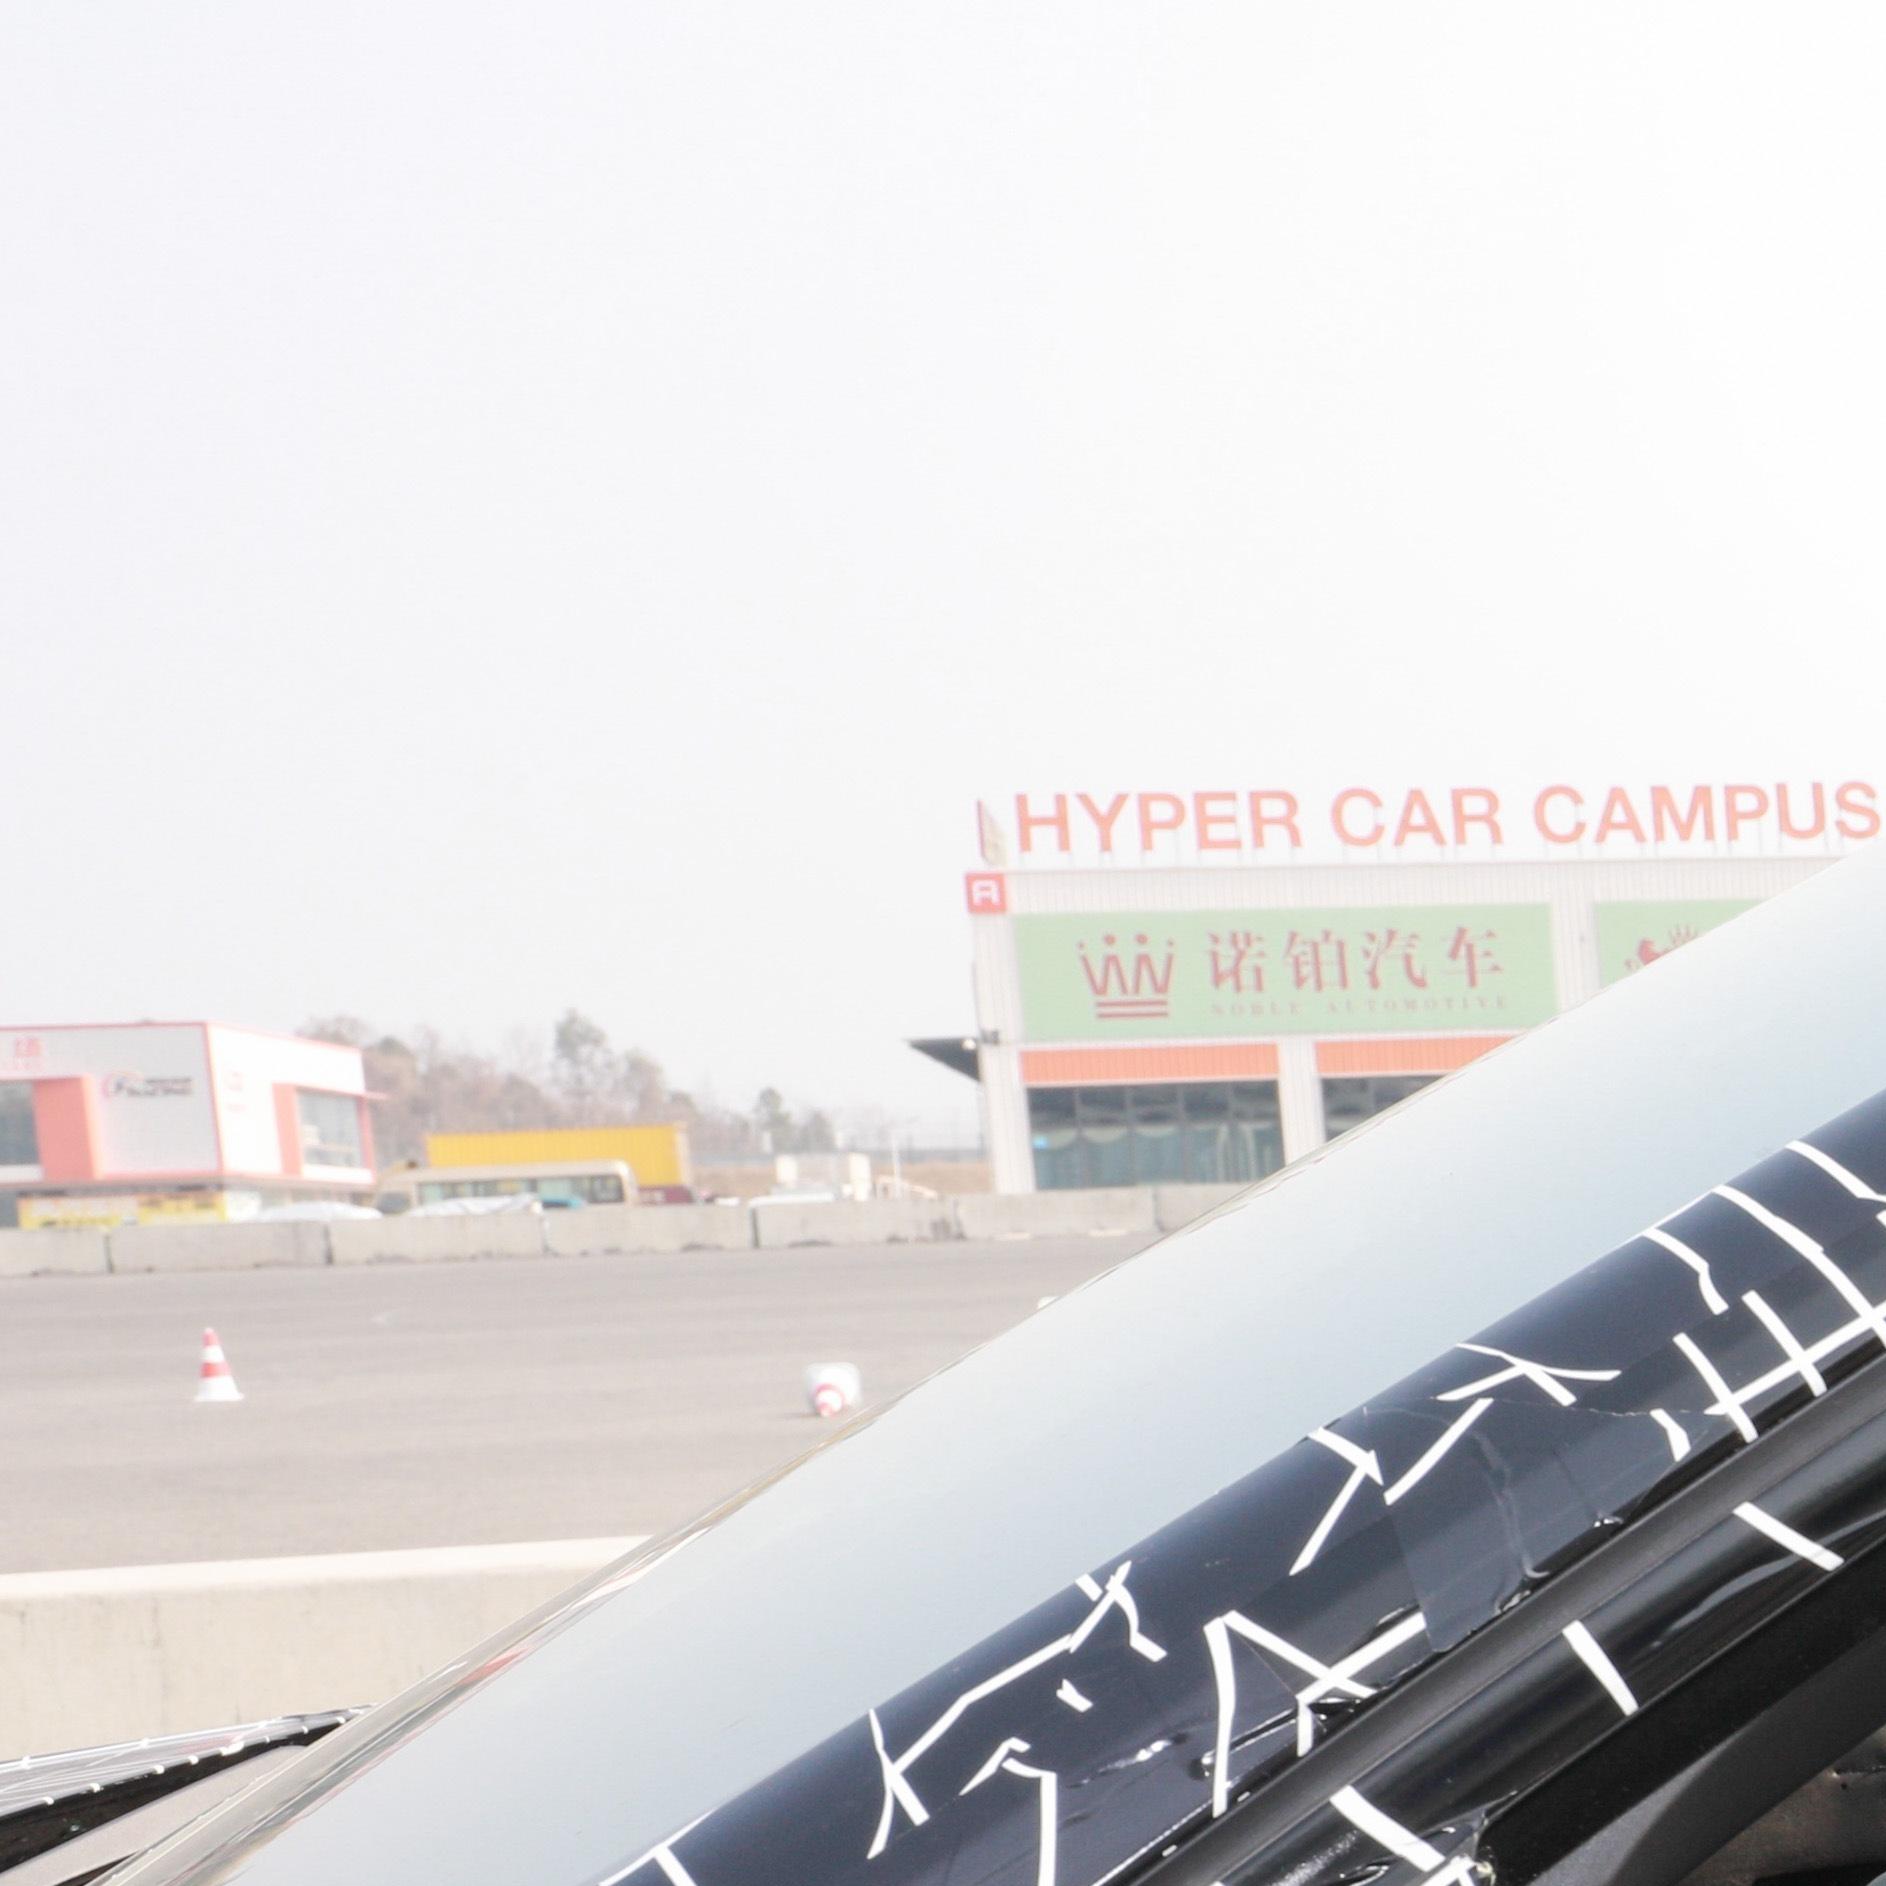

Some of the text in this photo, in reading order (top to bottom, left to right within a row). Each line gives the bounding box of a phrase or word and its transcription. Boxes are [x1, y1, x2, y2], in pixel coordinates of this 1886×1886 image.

[1014, 780, 1882, 853] HYPER CAR CAMPUS
[1206, 926, 1503, 993] 诺铂汽车
